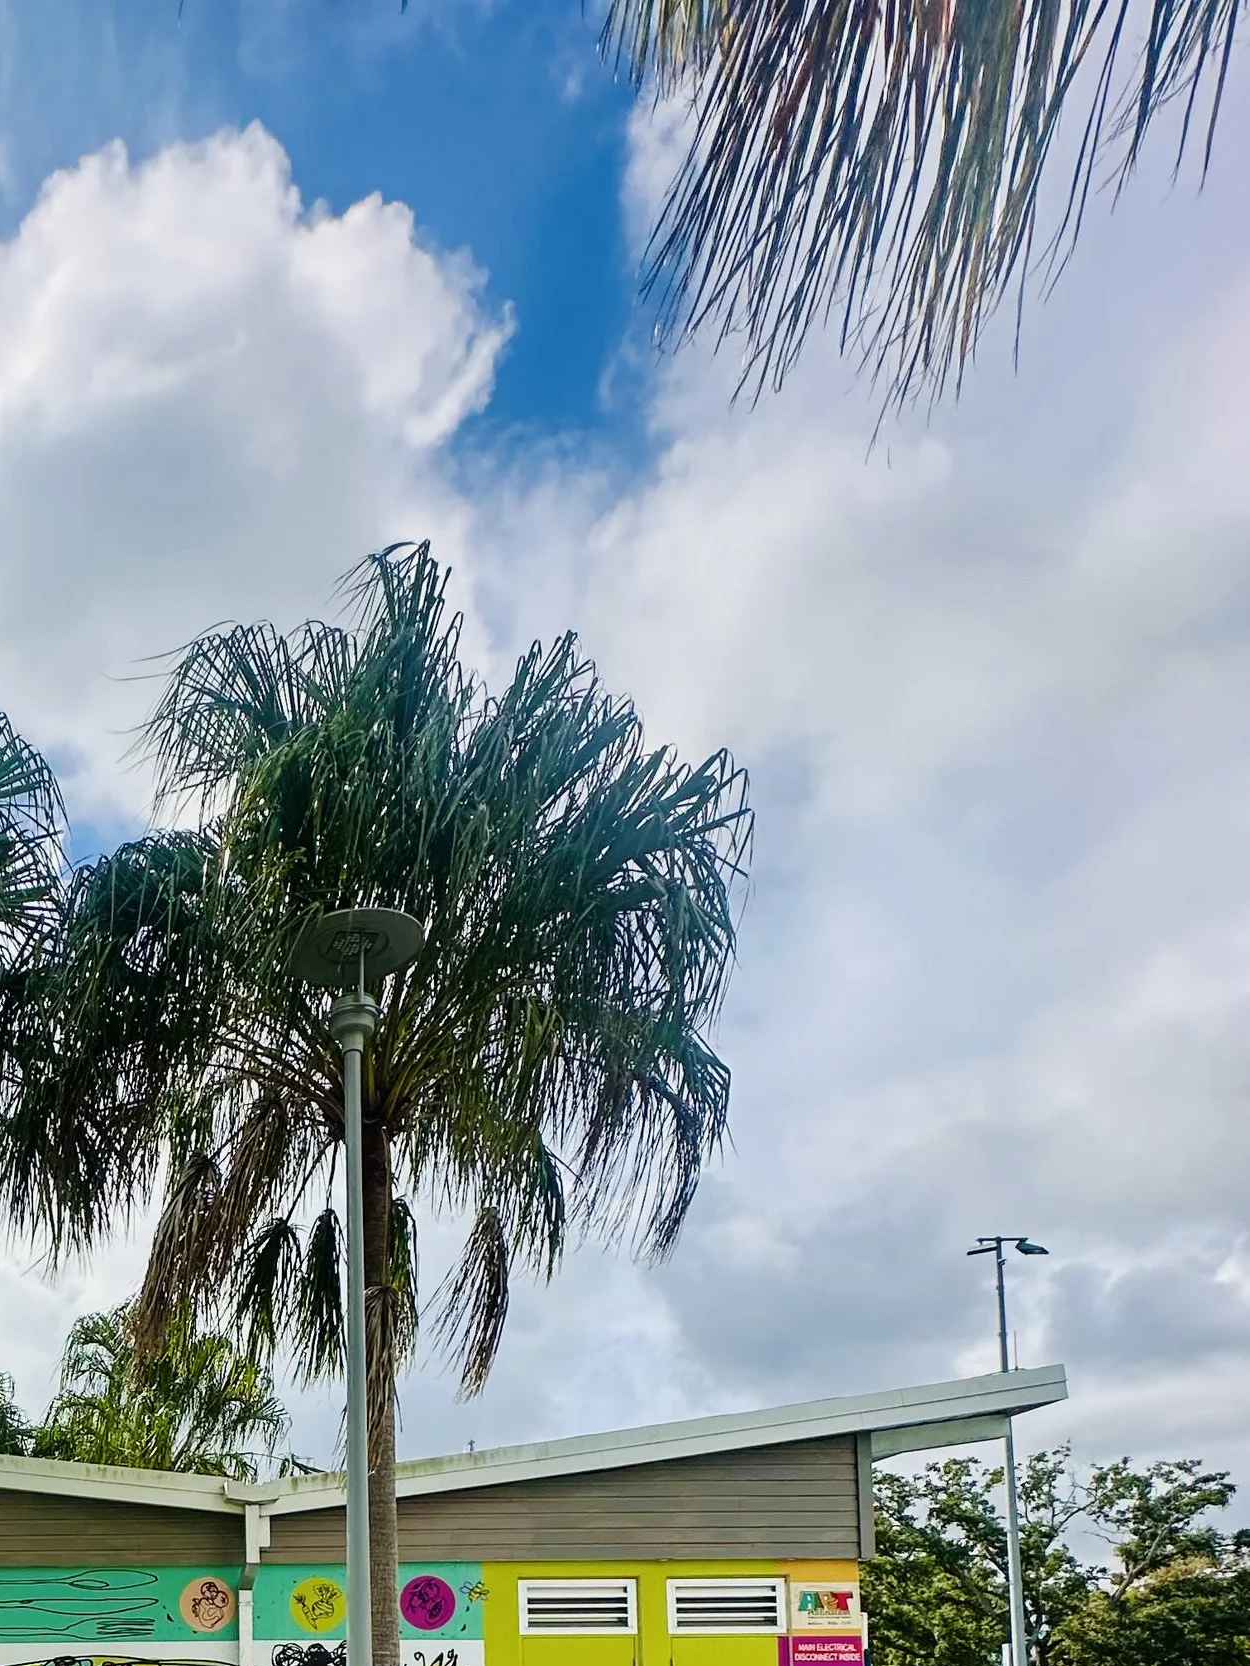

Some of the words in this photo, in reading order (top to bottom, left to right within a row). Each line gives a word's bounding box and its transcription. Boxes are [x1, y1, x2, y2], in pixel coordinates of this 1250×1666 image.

[798, 1591, 854, 1612] ART
[798, 1643, 816, 1652] MAIN
[816, 1643, 857, 1652] ELECTRICAL
[794, 1652, 838, 1661] DISCONNECT
[838, 1652, 862, 1661] INSIDE
